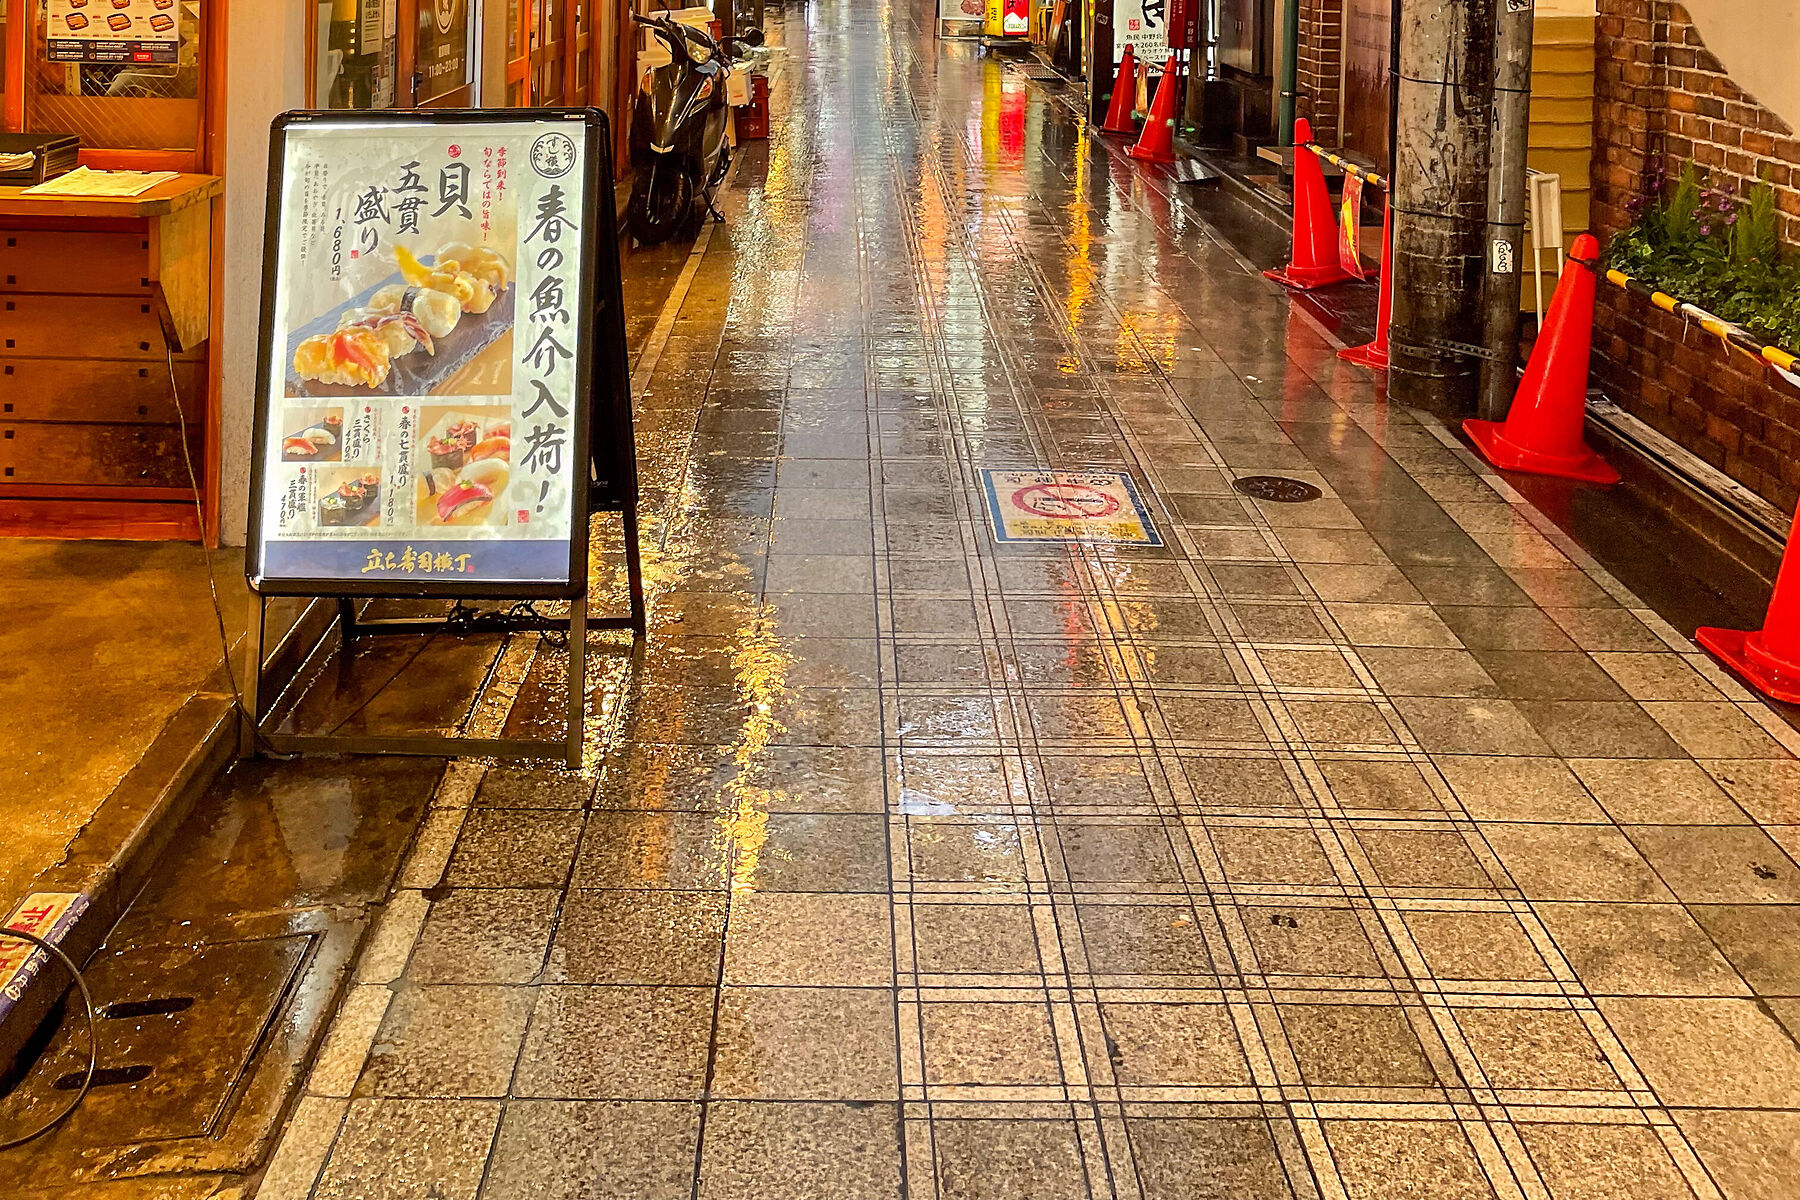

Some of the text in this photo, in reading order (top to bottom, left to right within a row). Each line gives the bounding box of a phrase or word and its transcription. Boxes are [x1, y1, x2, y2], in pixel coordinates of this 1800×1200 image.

[354, 185, 391, 256] 盛り
[391, 160, 429, 235] 五貫
[430, 162, 473, 220] 貝
[361, 545, 472, 574] 立ち寿司横丁
